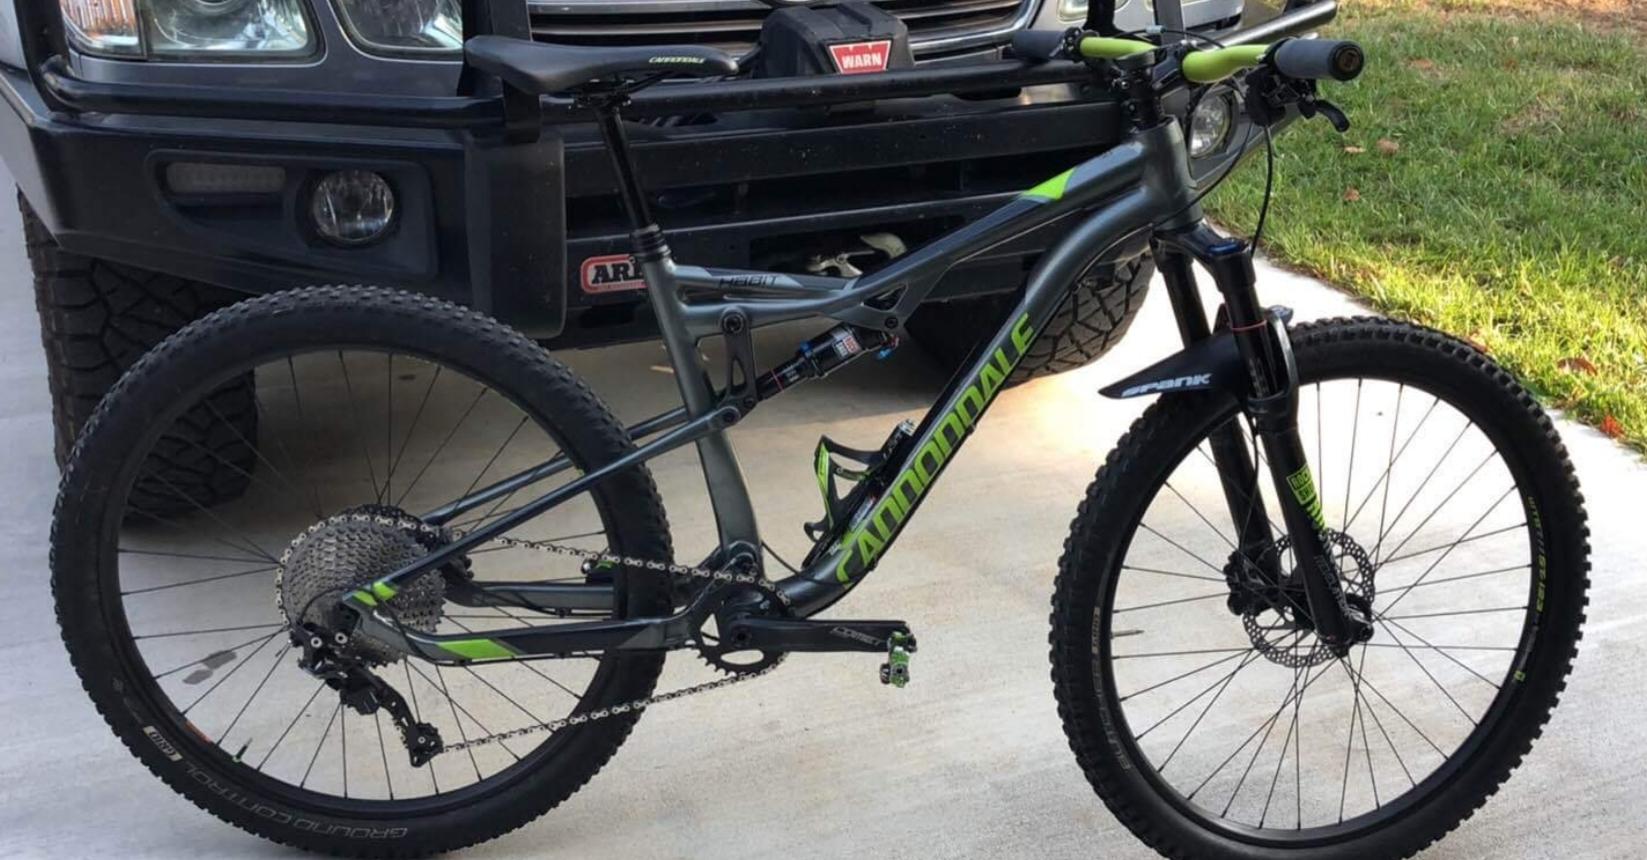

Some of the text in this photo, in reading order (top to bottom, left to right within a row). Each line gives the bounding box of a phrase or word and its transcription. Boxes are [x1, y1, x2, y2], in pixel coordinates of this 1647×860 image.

[841, 52, 883, 69] WARN
[591, 262, 643, 284] AR
[719, 275, 777, 287] HABIT
[1121, 373, 1212, 397] SPANK
[836, 312, 1034, 583] CANNONDALE
[186, 760, 408, 839] GROUND CONTROL
